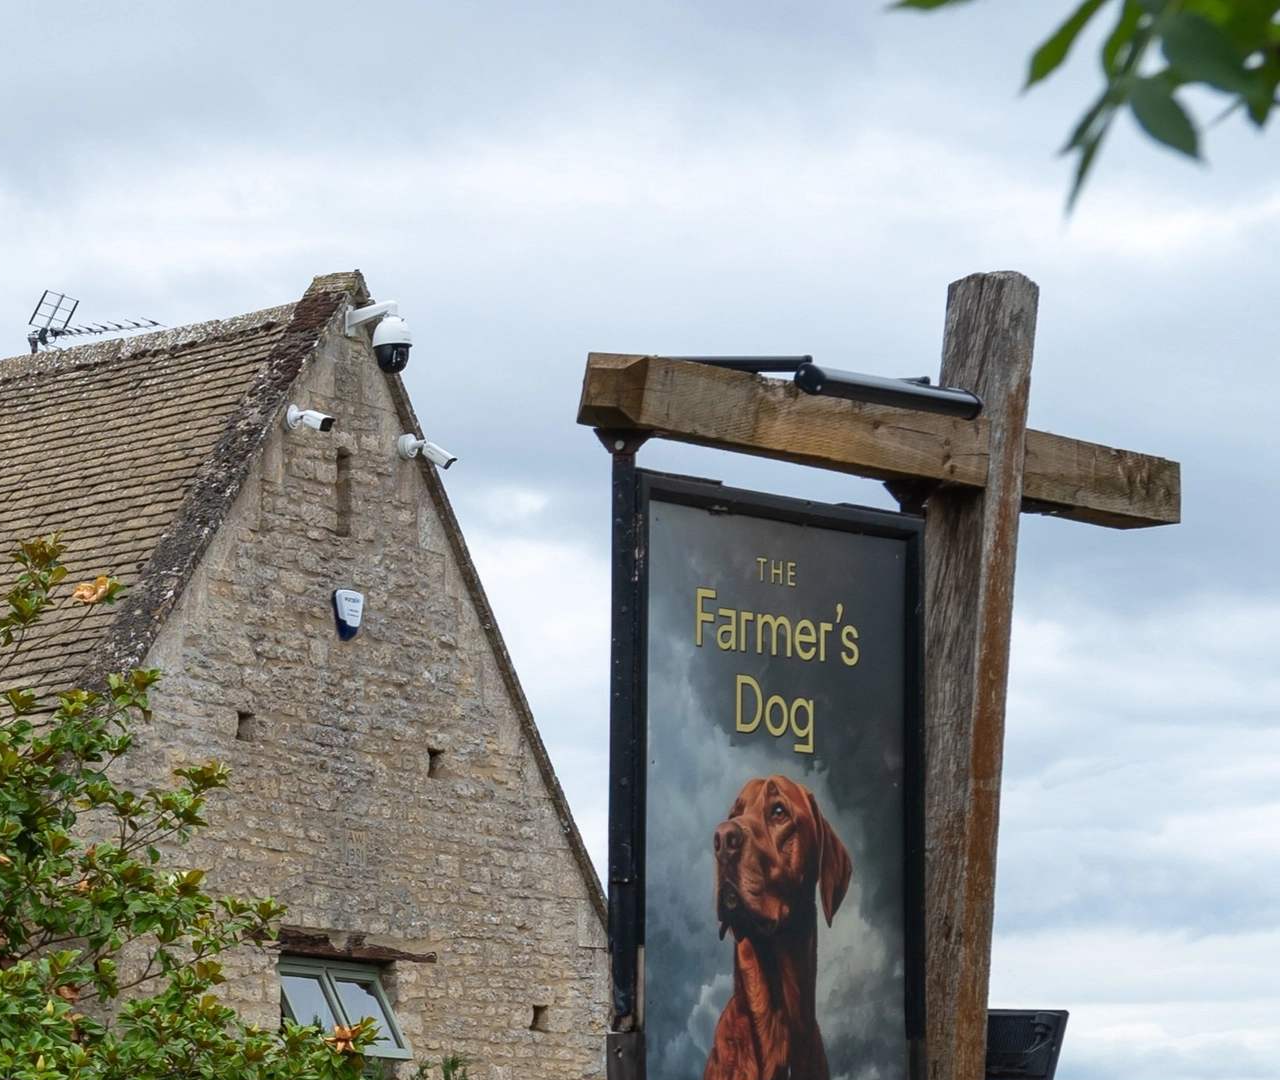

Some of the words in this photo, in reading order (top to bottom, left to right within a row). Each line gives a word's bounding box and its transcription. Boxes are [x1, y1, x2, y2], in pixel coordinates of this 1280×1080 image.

[756, 557, 796, 586] THE
[696, 587, 860, 666] Farmer's
[736, 674, 814, 753] Dog
